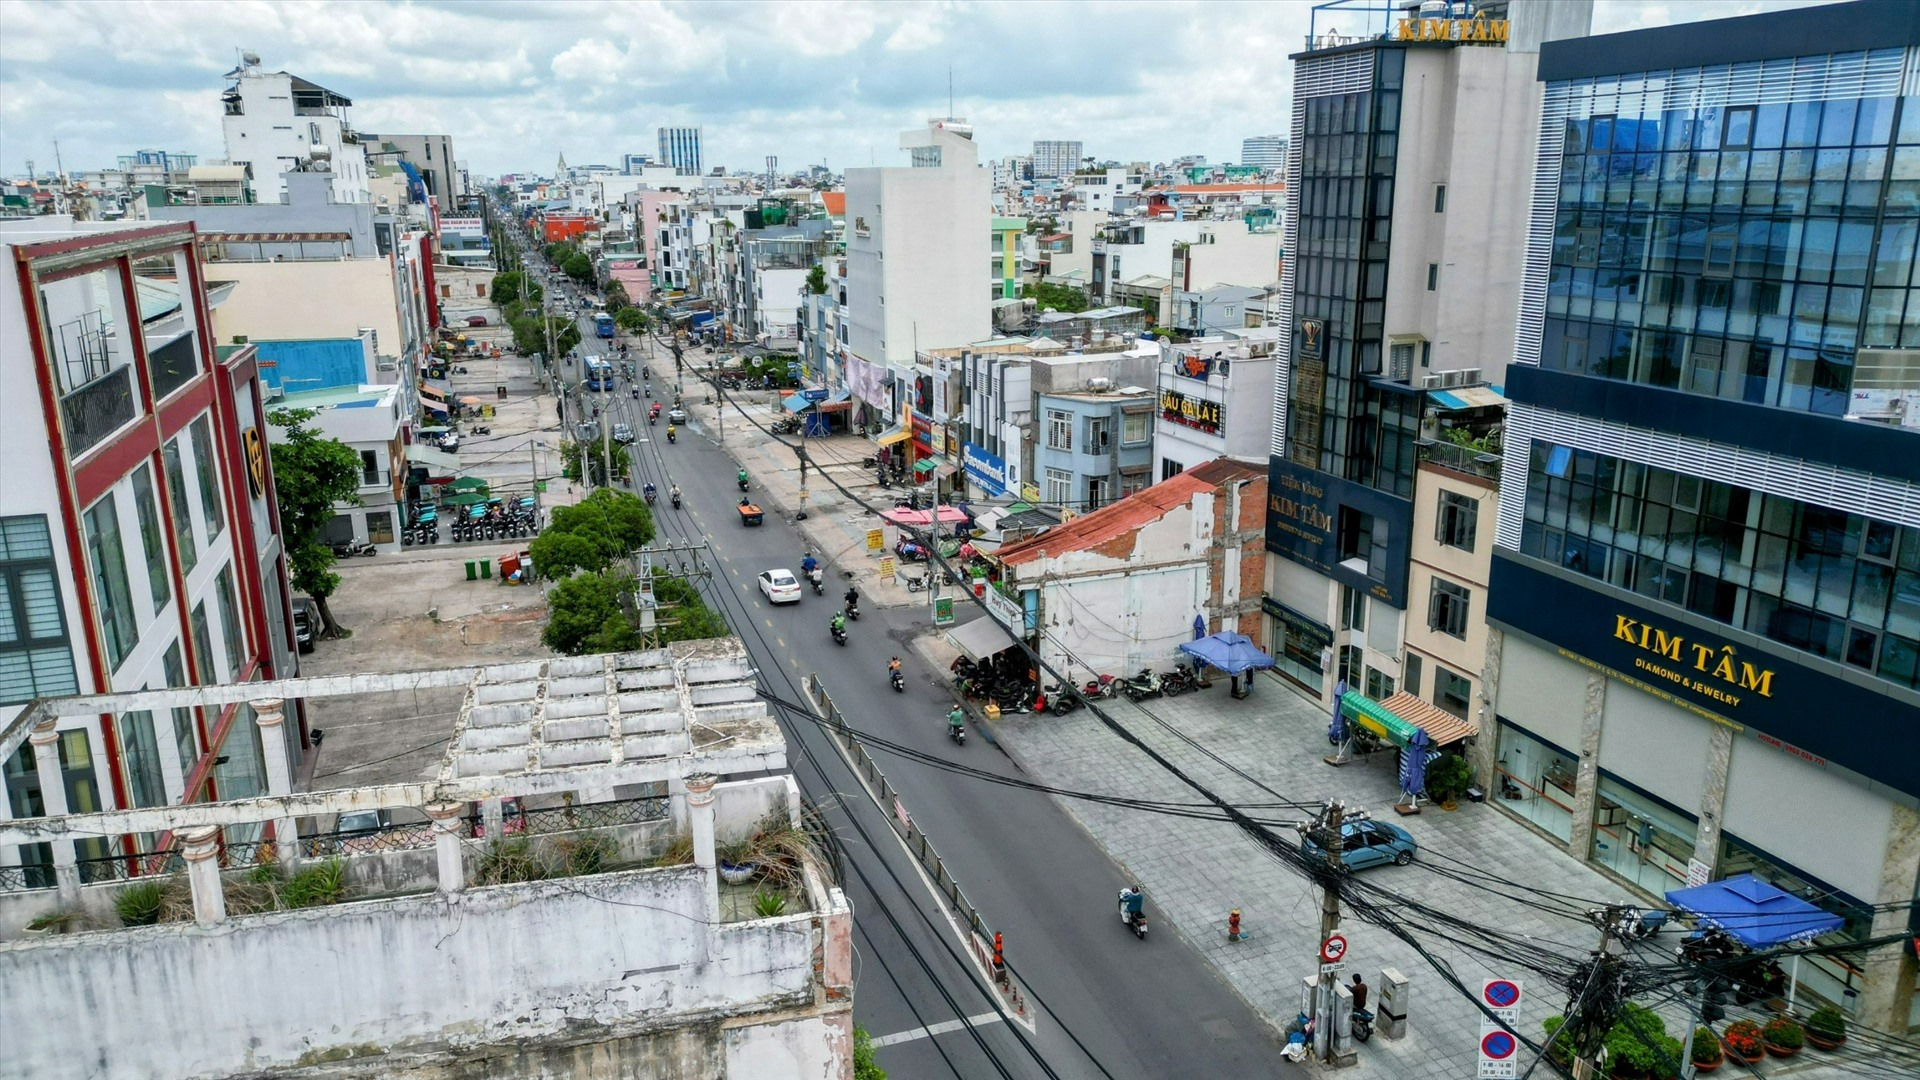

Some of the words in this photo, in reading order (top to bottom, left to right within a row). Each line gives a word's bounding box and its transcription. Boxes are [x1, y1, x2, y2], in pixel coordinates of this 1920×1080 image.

[1398, 18, 1450, 41] KIM
[1458, 10, 1510, 41] TÂM
[963, 445, 1005, 484] Sacombank
[1270, 493, 1299, 520] KIM
[1301, 503, 1333, 534] TÂM
[1613, 614, 1684, 662] KIM
[1691, 645, 1775, 697] TÂM
[1635, 657, 1681, 683] DIAMOND
[1682, 677, 1690, 687] &
[1691, 681, 1741, 707] JEWELRY
